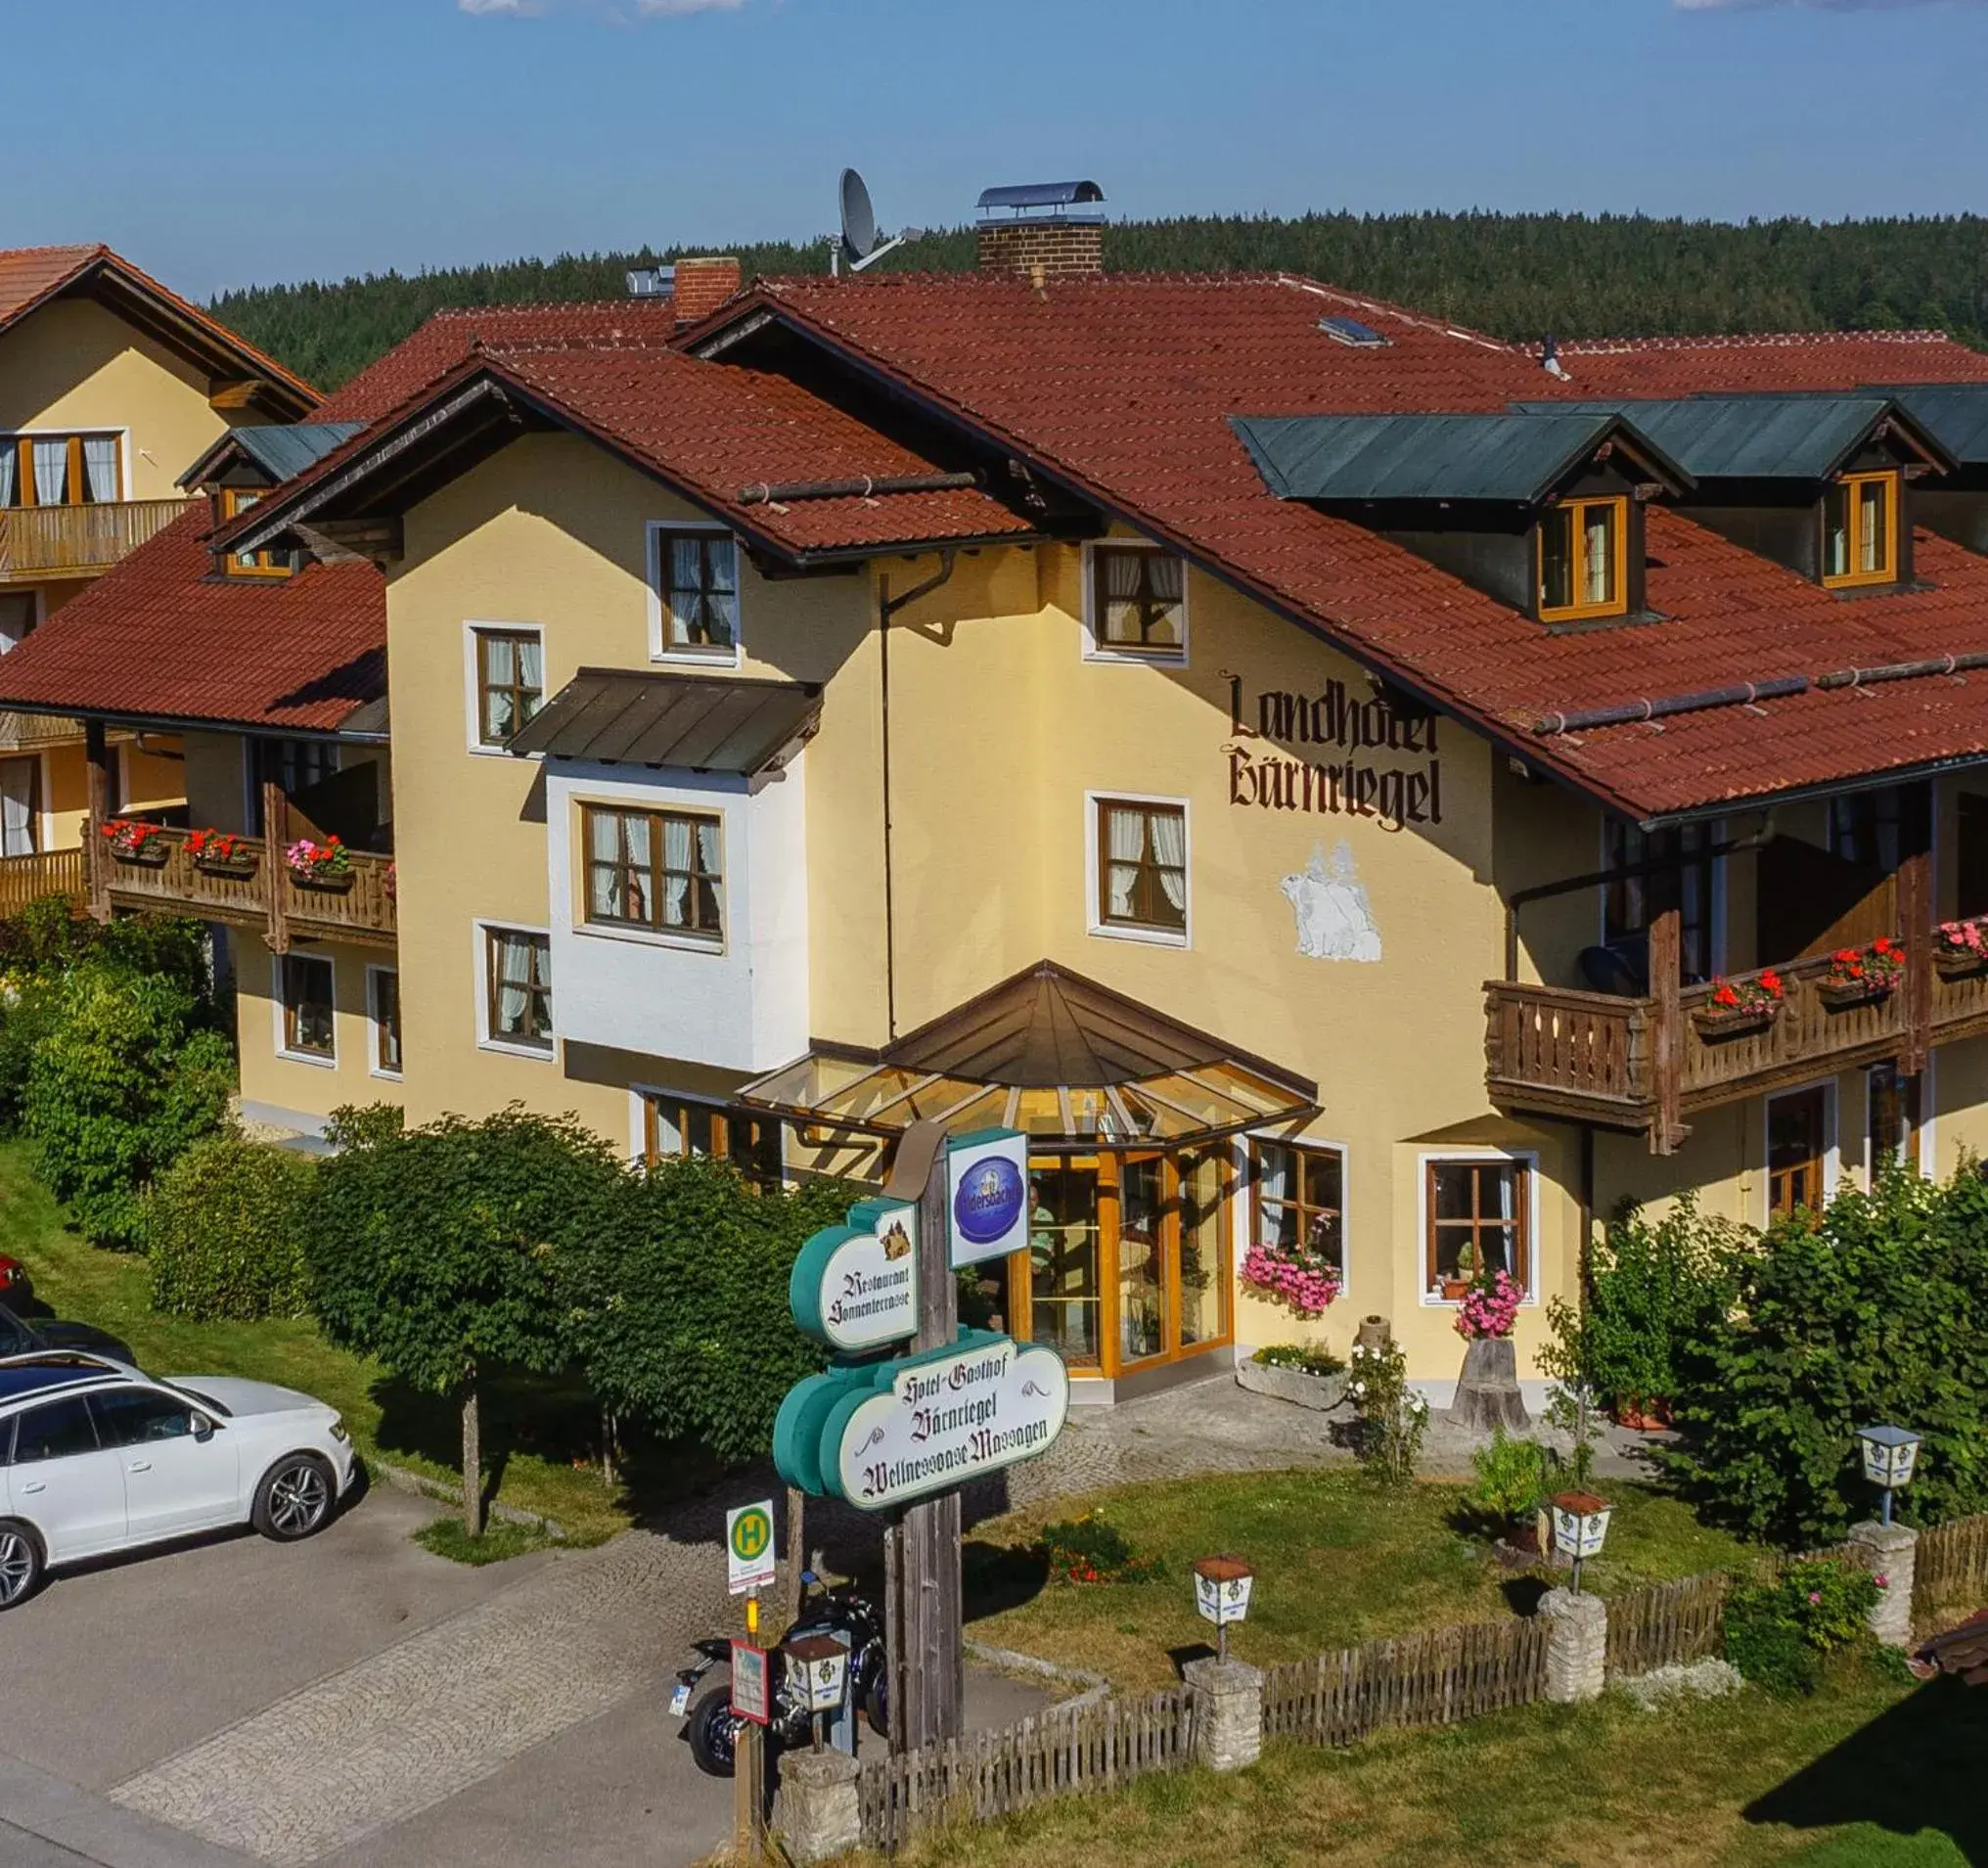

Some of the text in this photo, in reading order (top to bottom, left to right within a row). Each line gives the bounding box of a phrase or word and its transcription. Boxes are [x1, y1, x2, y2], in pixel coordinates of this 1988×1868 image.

[1220, 744, 1442, 833] Bärnriegel
[843, 1267, 910, 1299] Restaurant
[828, 1292, 910, 1327] Sonnenterrasse
[970, 1418, 1049, 1462] Massagen
[742, 1519, 761, 1552] H
